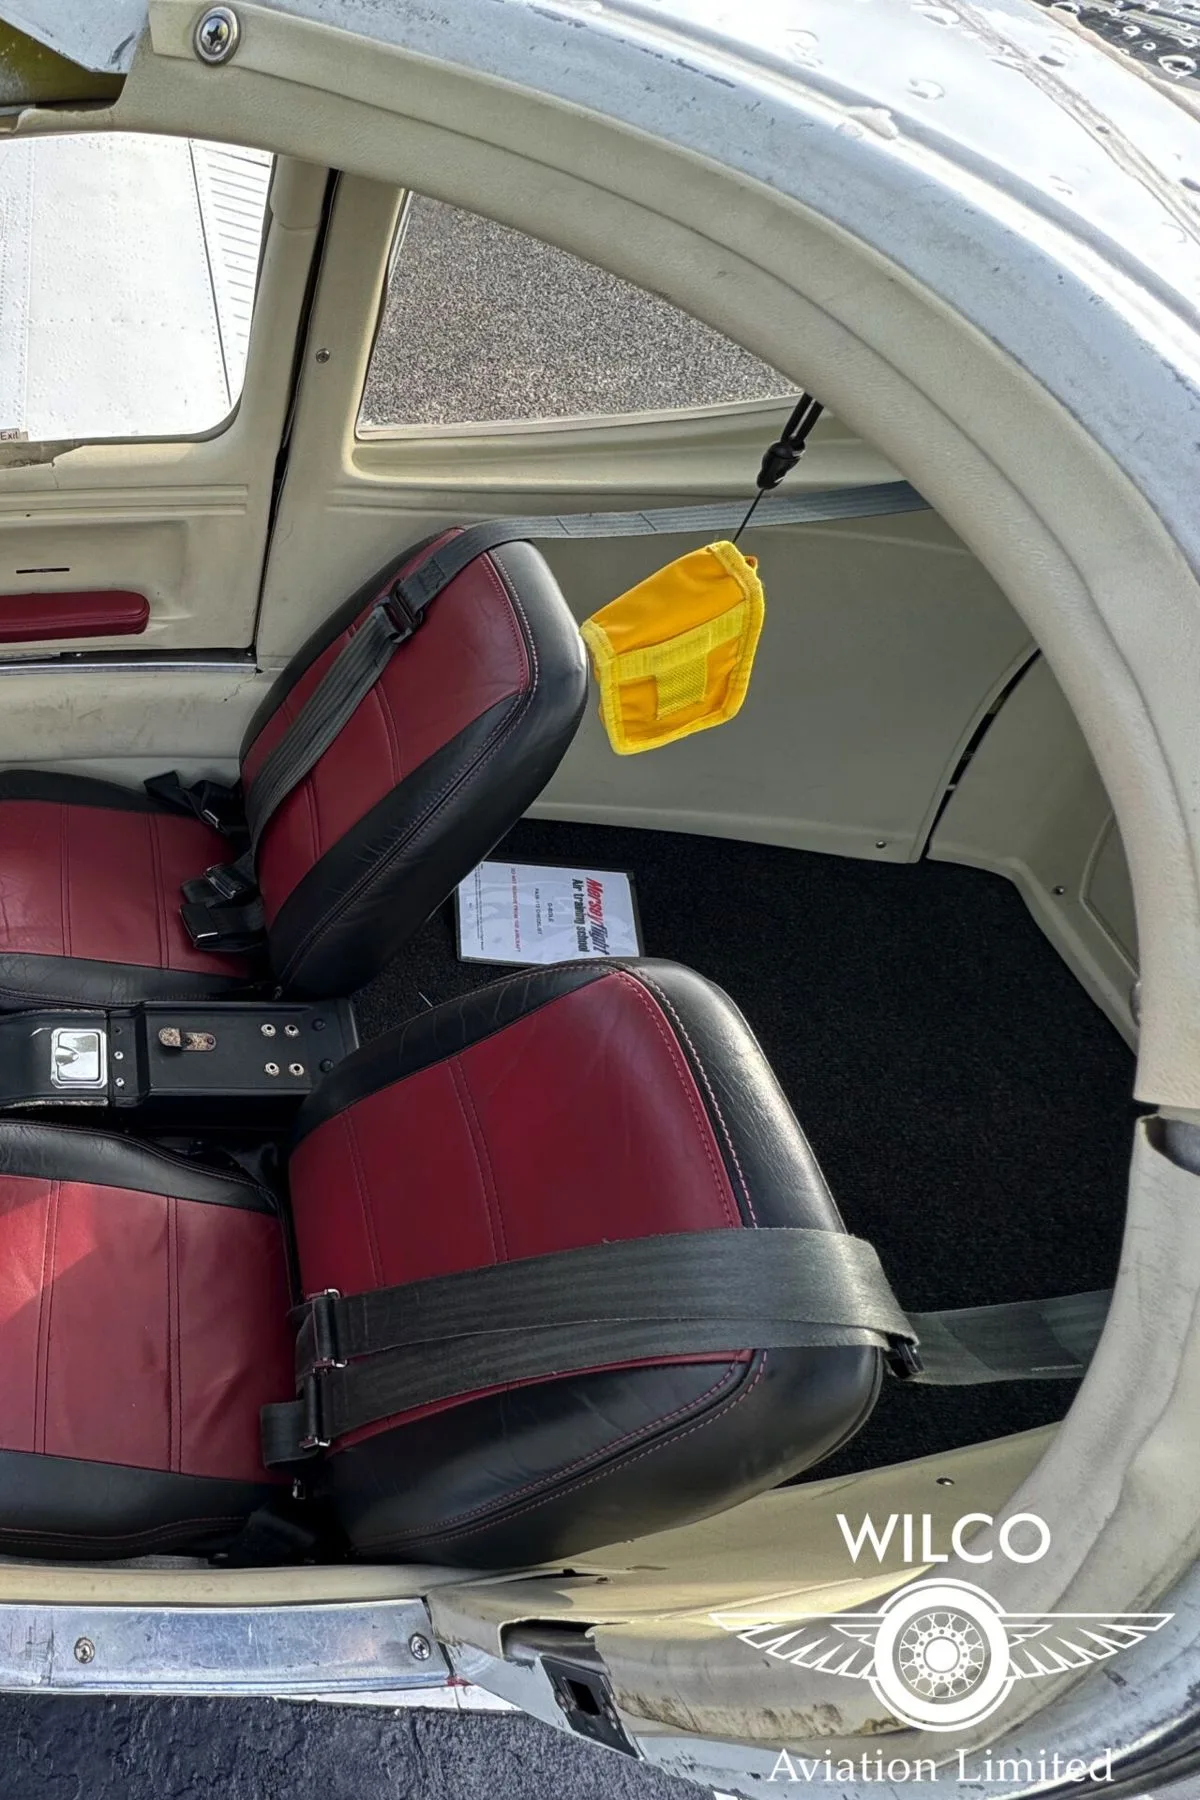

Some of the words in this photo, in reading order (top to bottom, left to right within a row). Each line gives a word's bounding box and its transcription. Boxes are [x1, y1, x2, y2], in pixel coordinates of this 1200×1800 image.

[0, 431, 19, 440] Exit
[572, 879, 584, 892] Air
[573, 894, 586, 925] training
[586, 878, 610, 955] Merseyflight
[576, 926, 590, 952] school
